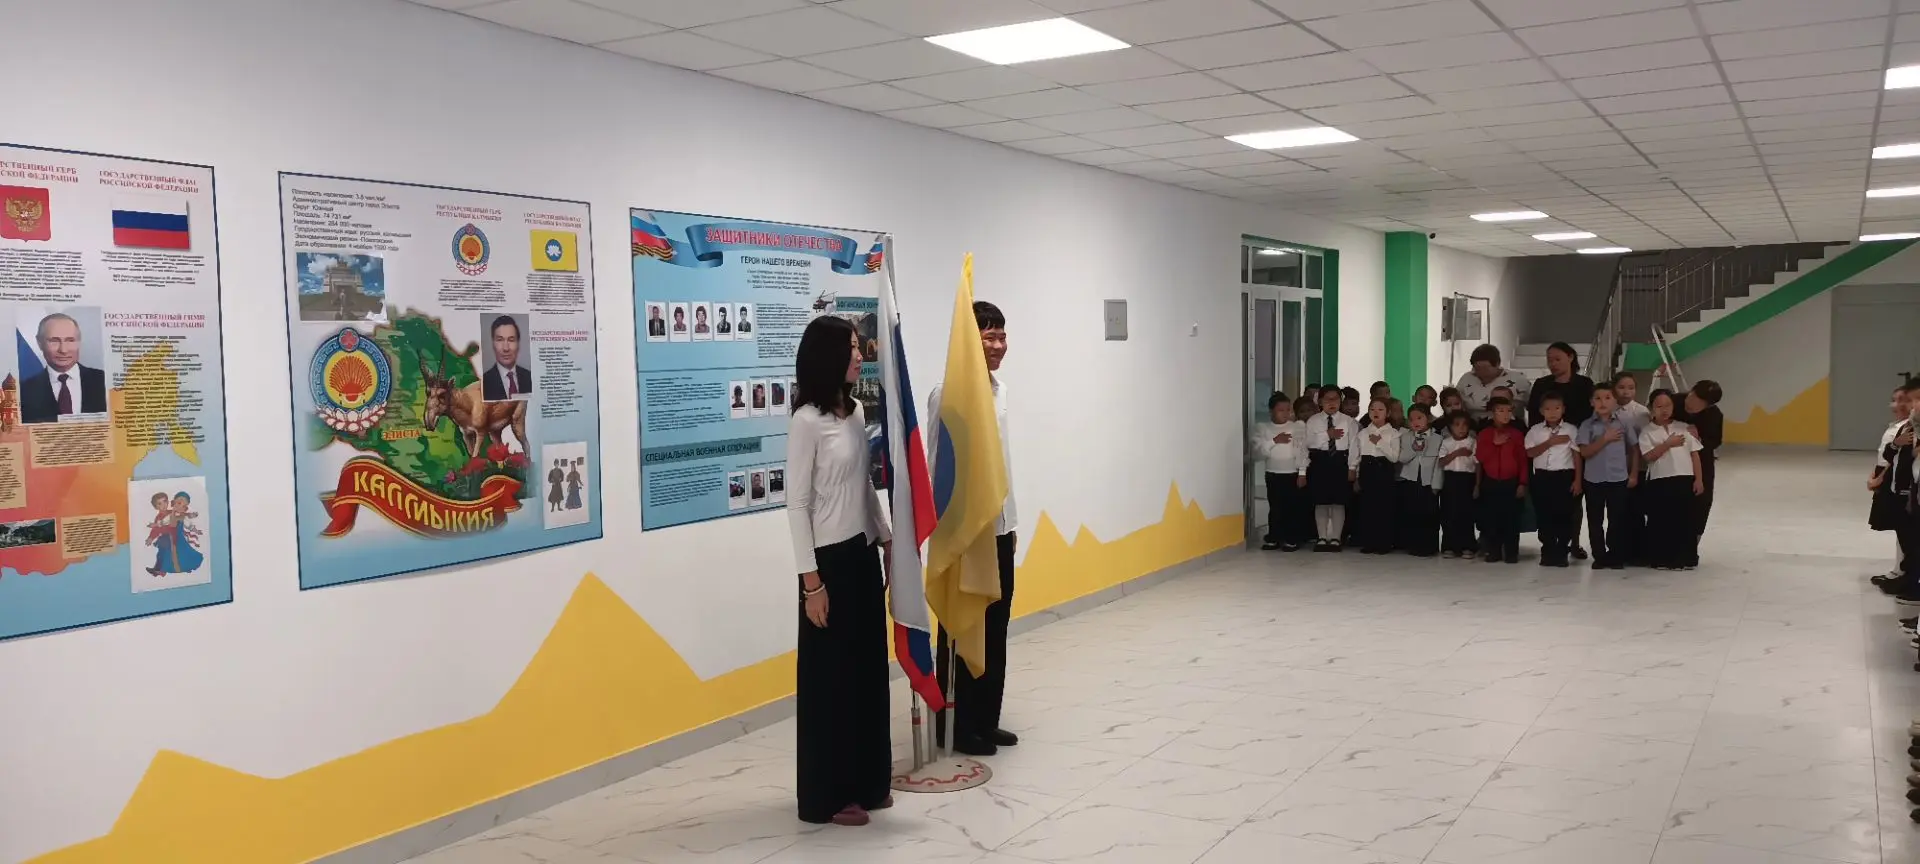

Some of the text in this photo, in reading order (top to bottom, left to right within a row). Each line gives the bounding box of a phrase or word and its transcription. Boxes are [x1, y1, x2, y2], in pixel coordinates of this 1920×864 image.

[56, 166, 77, 175] ГЕРБ
[99, 170, 177, 183] ГОСУДАРСТВЕННЫЙ
[27, 172, 79, 183] ФЕДЕРАЦИИ
[99, 178, 199, 193] РОССИЙСКОЙ ФЕДЕРАЦИИ
[706, 227, 843, 252] ЗАЩИТНИКИ ОТЕЧЕСТВА
[741, 255, 811, 267] ГЕРОИ НАШЕГО ВРЕМЕНИ
[104, 312, 206, 321] ГОСУДАРСТВЕННЫЙ ГИМН
[105, 320, 206, 329] РОССИЙСКОЙ ФЕДЕРАЦИИ
[383, 429, 421, 441] ЭЛИСТА
[645, 449, 695, 462] СПЕЦИАЛЬНАЯ
[696, 446, 726, 456] ВОЕННАЯ
